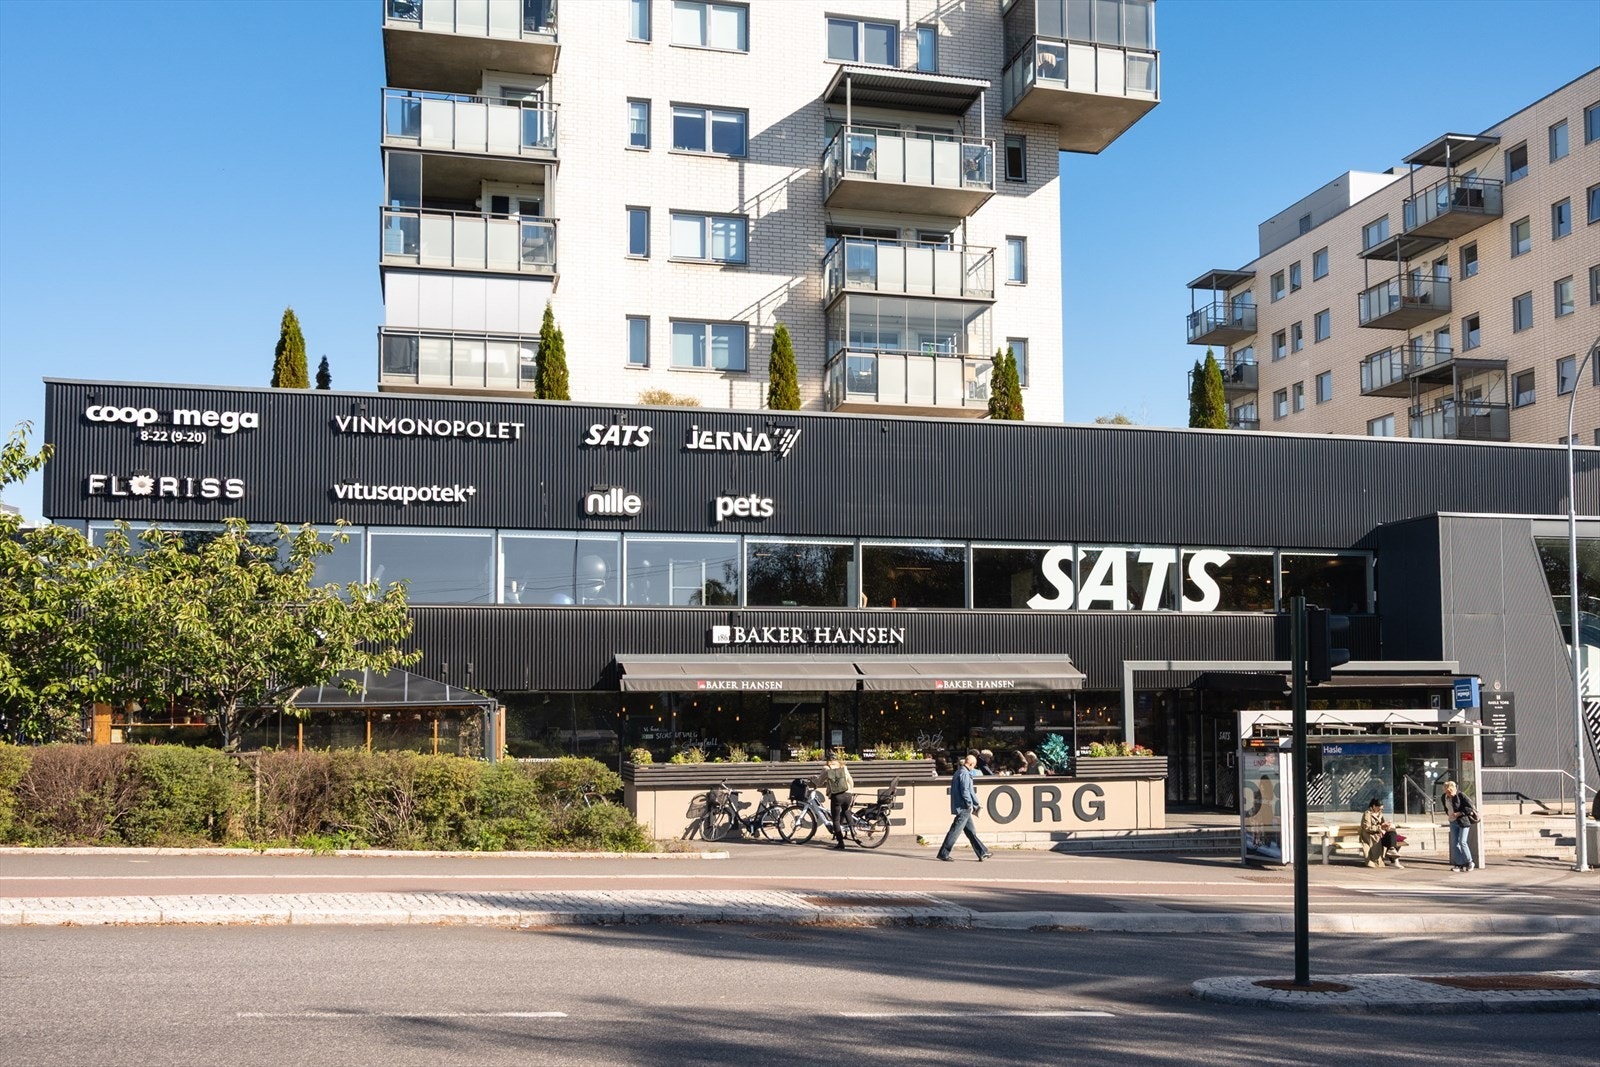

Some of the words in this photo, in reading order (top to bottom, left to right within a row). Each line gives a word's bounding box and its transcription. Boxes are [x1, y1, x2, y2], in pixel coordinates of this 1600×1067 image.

[85, 405, 159, 427] coop
[172, 409, 259, 434] mega
[335, 415, 525, 440] VINMONOPOLET
[140, 430, 168, 442] 8-22
[170, 431, 207, 445] (9-20)
[585, 423, 653, 447] SATS
[587, 487, 642, 514] nille
[716, 493, 774, 522] pets
[1026, 545, 1232, 613] SATS
[733, 626, 807, 644] BAKER
[814, 627, 906, 644] HANSEN
[706, 680, 739, 690] BAKER
[741, 680, 783, 690] HANSEN
[943, 680, 974, 689] BAKER
[976, 680, 1015, 689] HANSEN
[1323, 745, 1343, 754] Hasle
